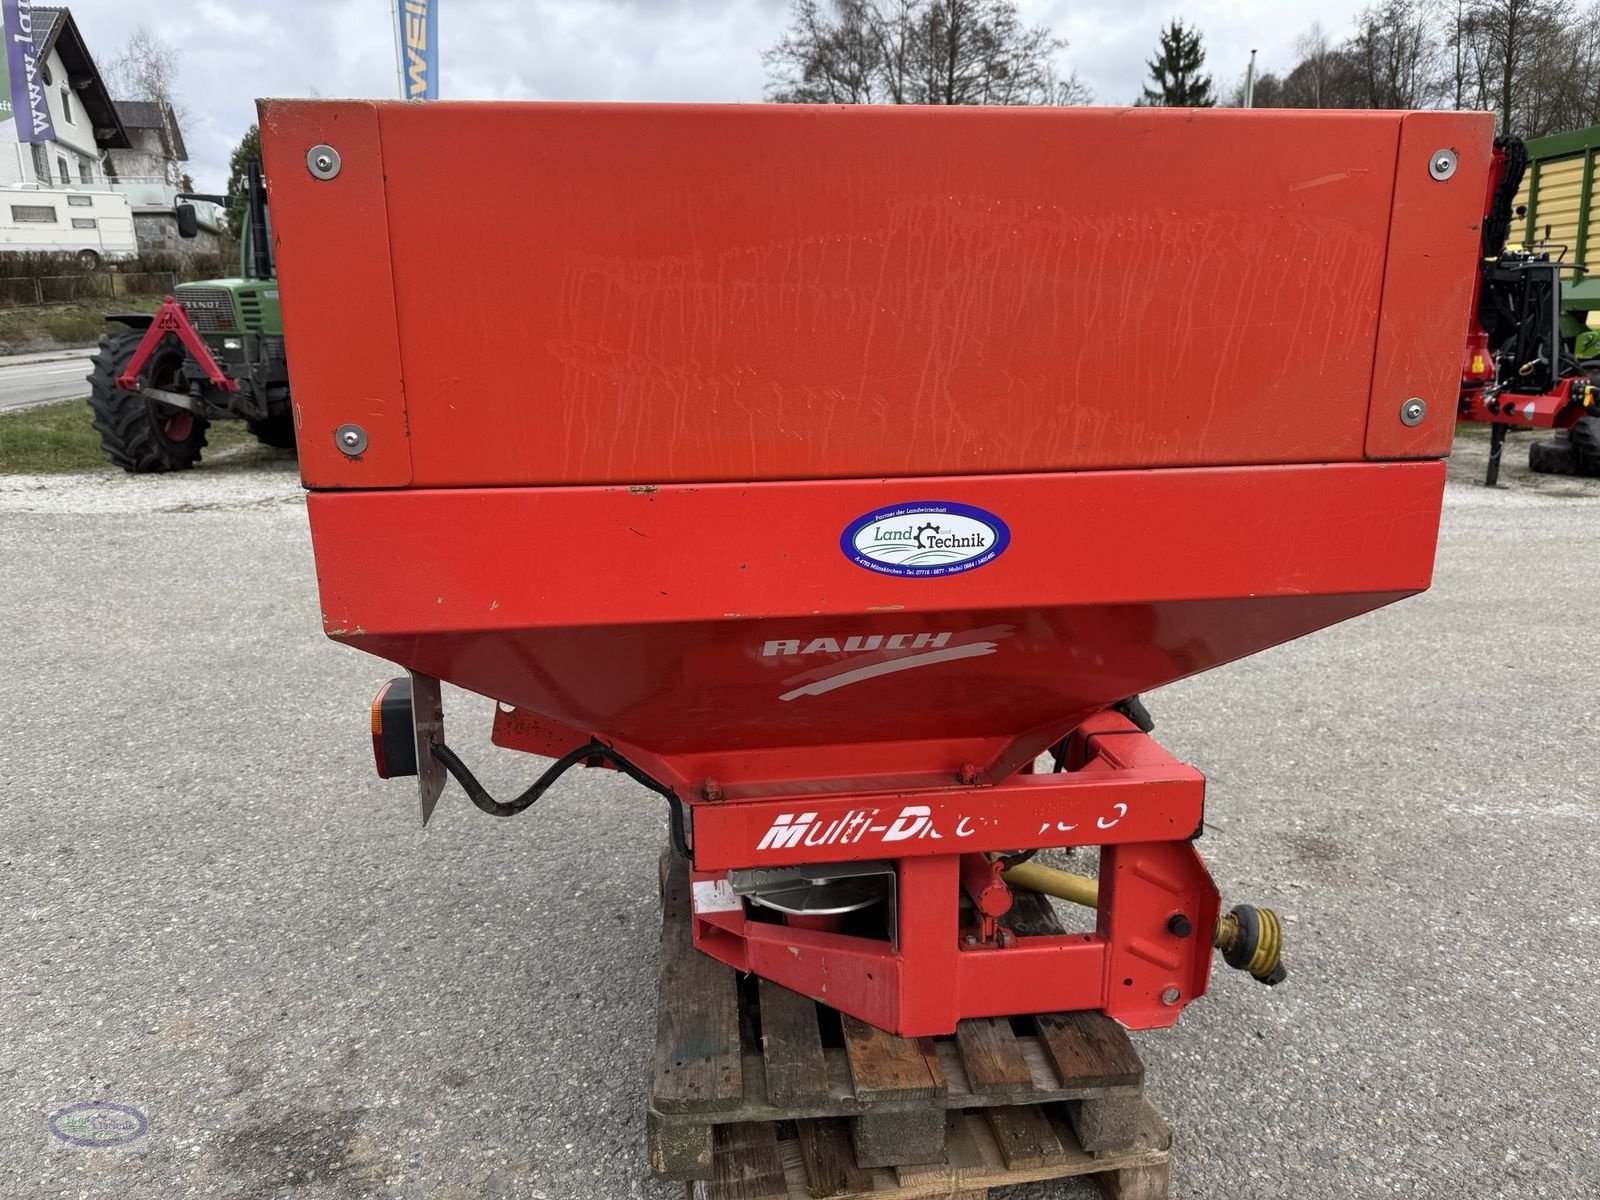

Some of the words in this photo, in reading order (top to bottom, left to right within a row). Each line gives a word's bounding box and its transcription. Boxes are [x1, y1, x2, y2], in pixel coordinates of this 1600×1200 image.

[405, 0, 427, 95] WEI
[875, 512, 895, 521] Partner
[874, 526, 913, 541] Land
[927, 533, 985, 548] Technik
[762, 632, 952, 656] RAUCH
